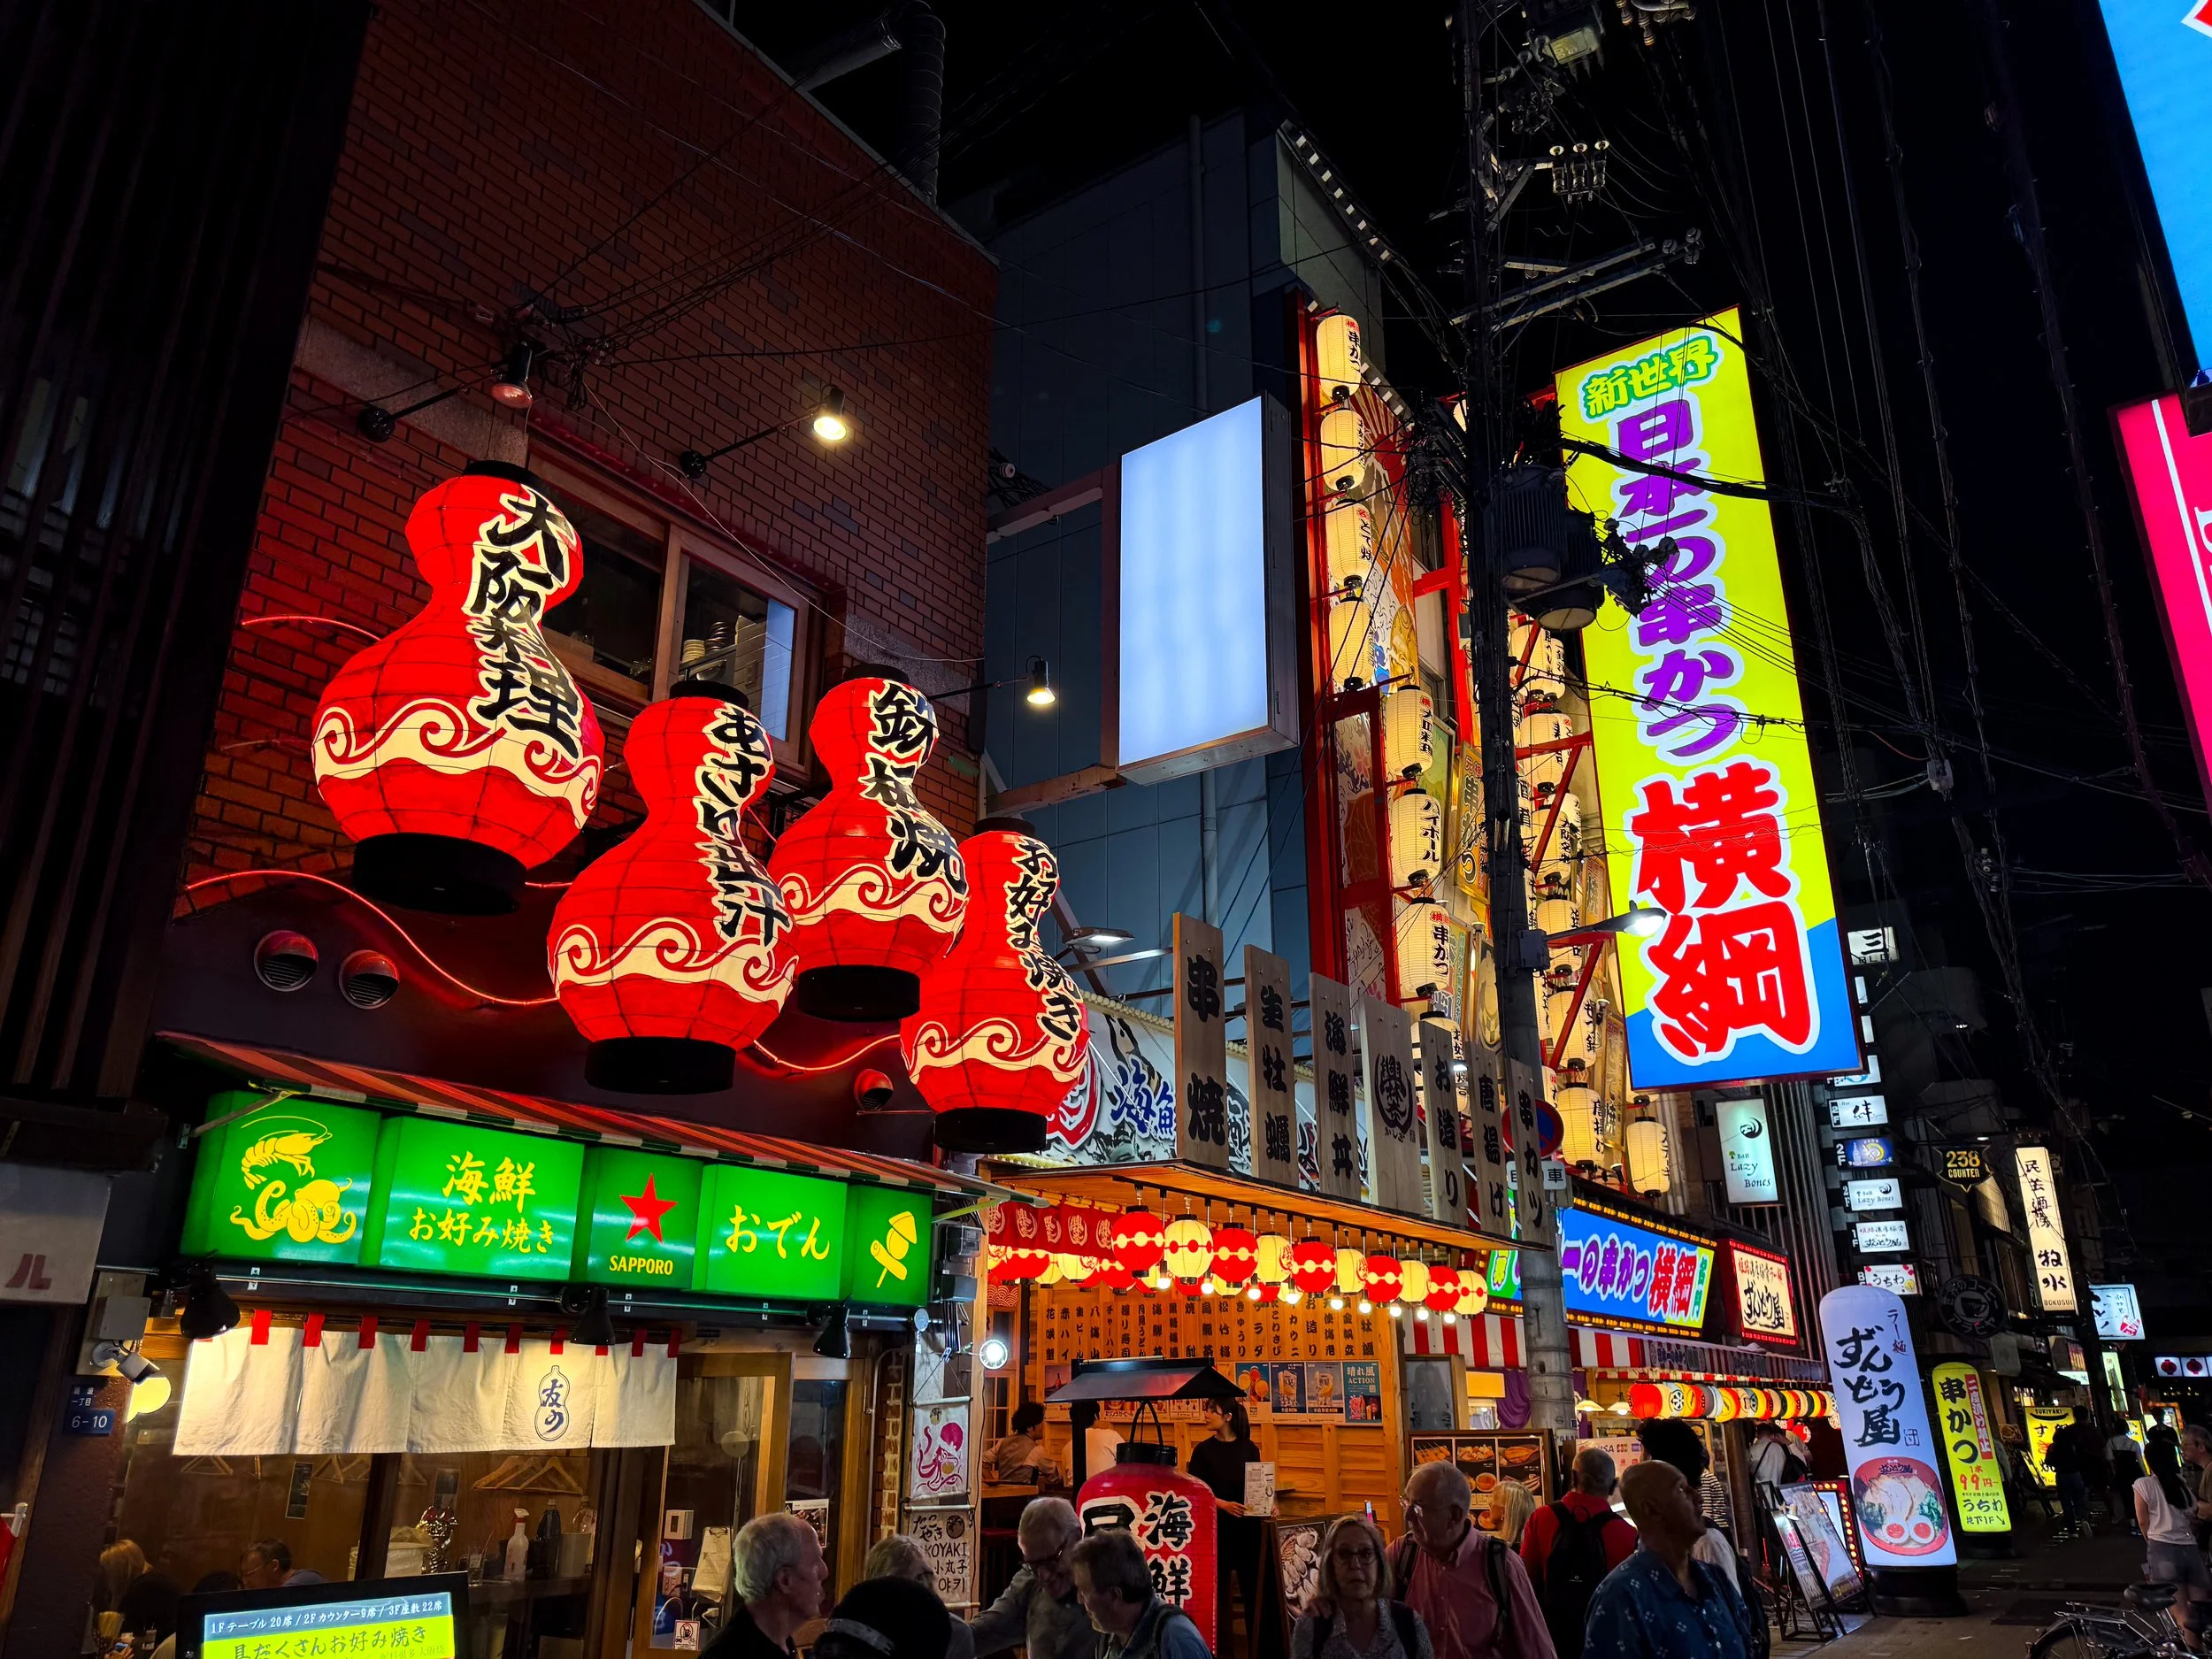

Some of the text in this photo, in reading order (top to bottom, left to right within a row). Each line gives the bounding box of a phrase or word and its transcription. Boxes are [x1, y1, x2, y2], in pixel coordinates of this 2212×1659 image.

[1583, 335, 1717, 417] 新世界
[470, 495, 579, 759] 大阪料理
[867, 685, 965, 895] 鉄板焼
[1632, 762, 1811, 1057] 横綱
[1010, 841, 1082, 1039] お好み焼き
[1432, 925, 1449, 975] 串かつ
[1187, 955, 1226, 1146] 串焼
[1435, 1056, 1458, 1207] お造り
[1479, 1073, 1504, 1217] 唐揚げ
[1836, 1143, 1846, 1166] 2F
[443, 1151, 536, 1211] 海鮮
[1518, 1089, 1543, 1227] 串カツ
[1947, 1151, 1981, 1167] 238
[1948, 1168, 1980, 1178] COUNTER
[411, 1207, 553, 1254] お好み焼き
[726, 1205, 830, 1260] おでん
[609, 1255, 673, 1275] SAPPORO
[1649, 1246, 1698, 1317] 横綱
[1873, 1274, 1905, 1287] うちわ
[2038, 1249, 2067, 1292] 牧水
[1186, 1302, 1195, 1357] 焼酎
[1219, 1301, 1230, 1357] 松竹梅
[1236, 1301, 1246, 1356] きゅうり
[1289, 1308, 1299, 1356] カウニ
[1361, 1318, 1374, 1356] 牡蠣
[1347, 1367, 1375, 1377] 晴れ風
[72, 1416, 107, 1428] 6-10
[1939, 1376, 1978, 1464] 串かつ
[1963, 1499, 2003, 1512] うちわ
[926, 1542, 967, 1557] KOYAKI
[934, 1560, 967, 1575] 小丸子
[939, 1578, 965, 1593] 야키
[211, 1622, 224, 1634] 1F
[227, 1620, 266, 1632] テーブル
[271, 1616, 293, 1628] 20席
[304, 1613, 316, 1624] 2F
[423, 1600, 442, 1612] 22席
